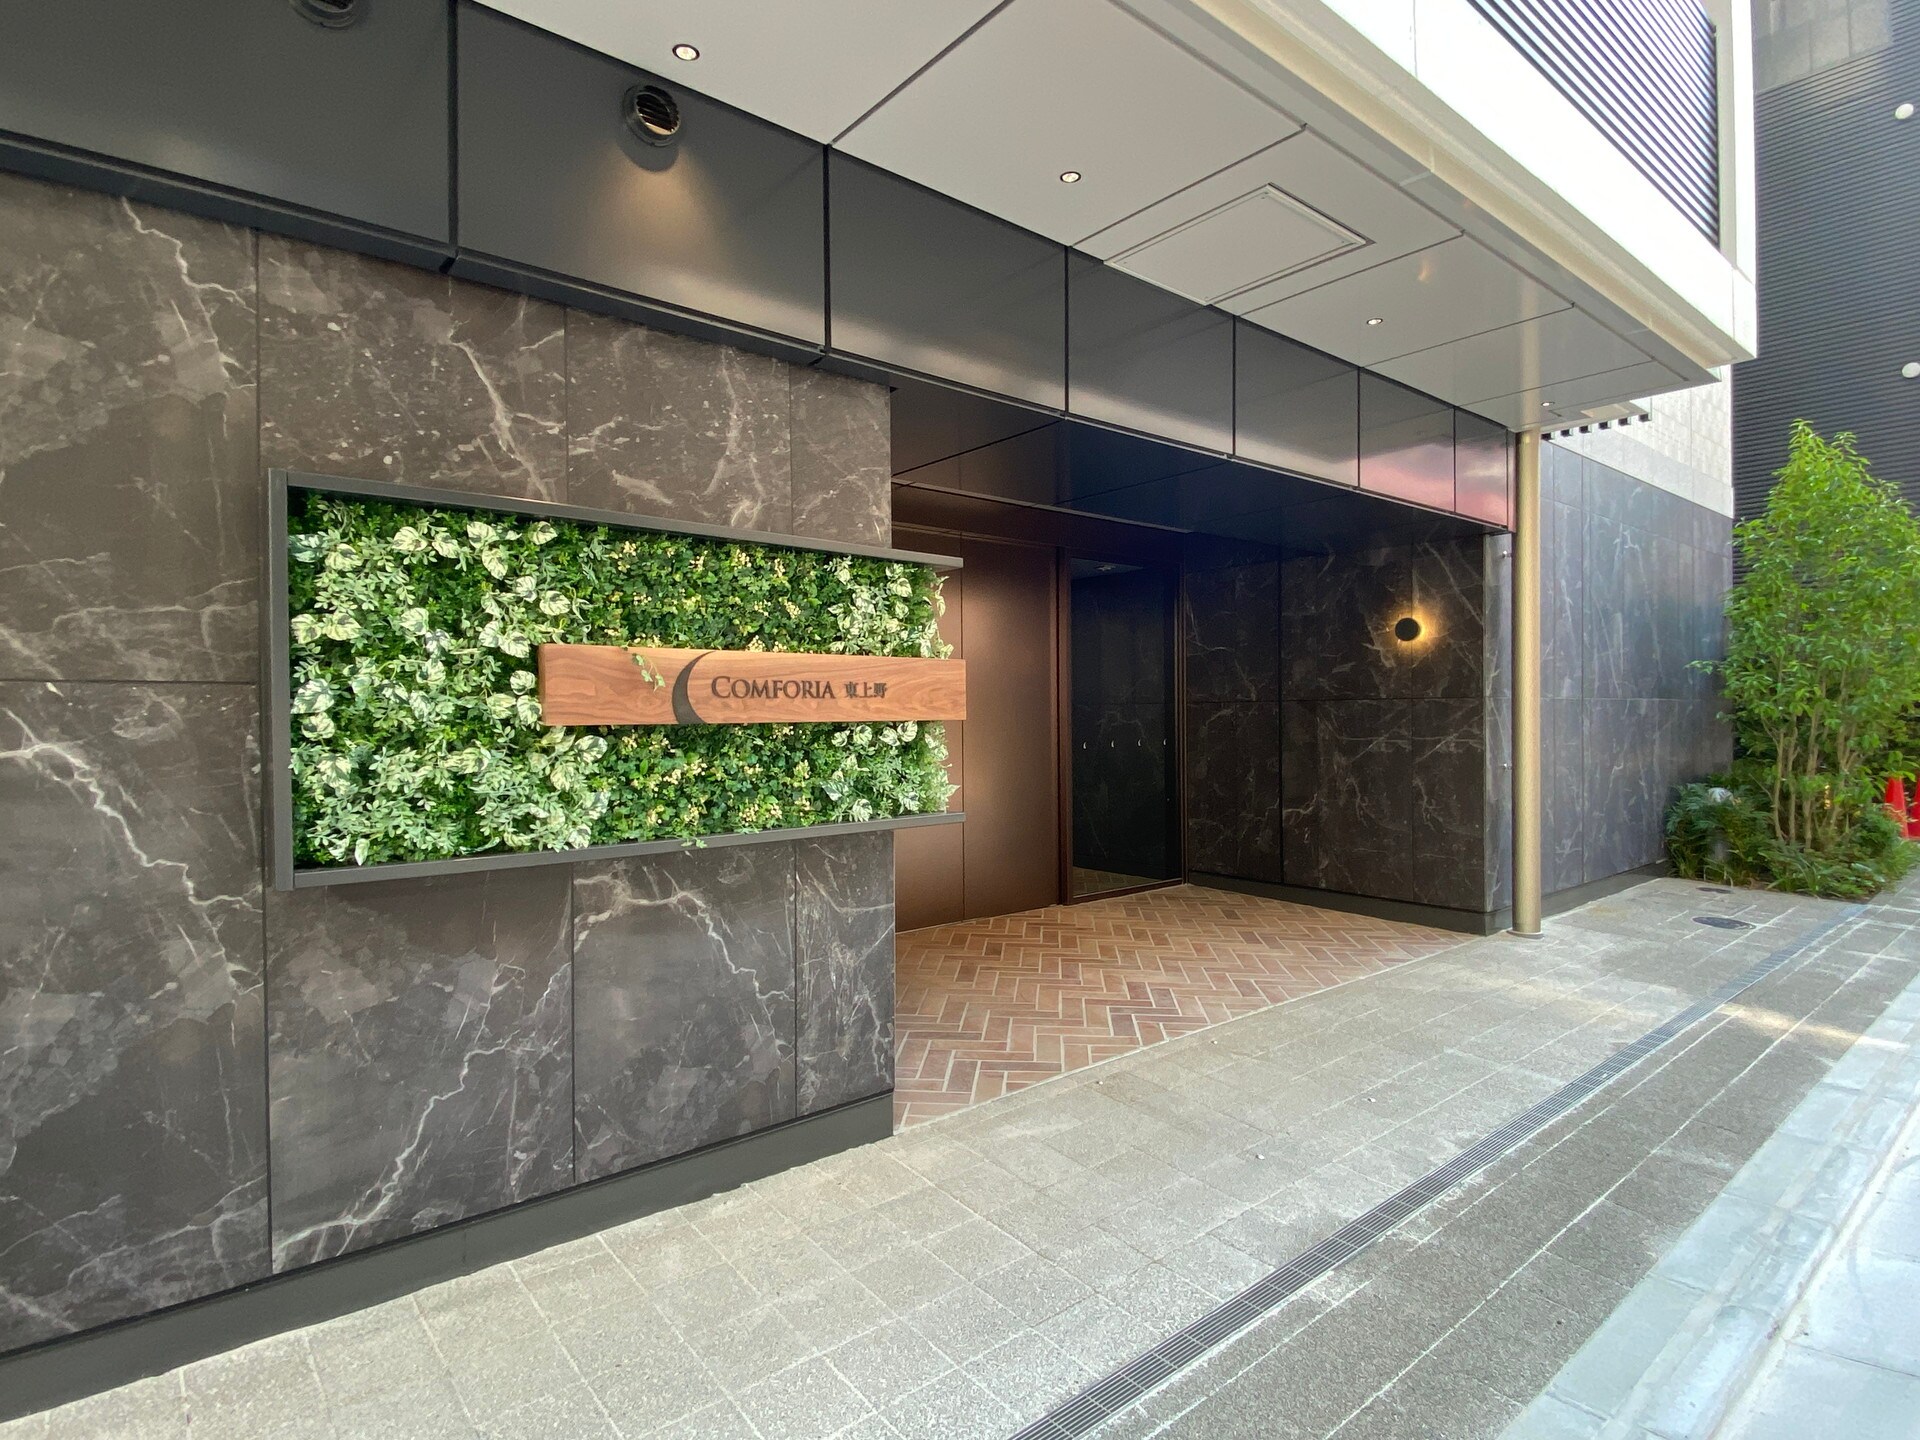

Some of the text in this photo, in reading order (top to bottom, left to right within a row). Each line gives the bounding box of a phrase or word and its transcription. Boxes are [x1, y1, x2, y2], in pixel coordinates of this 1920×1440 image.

[711, 675, 887, 699] COMFORIA 東上野
